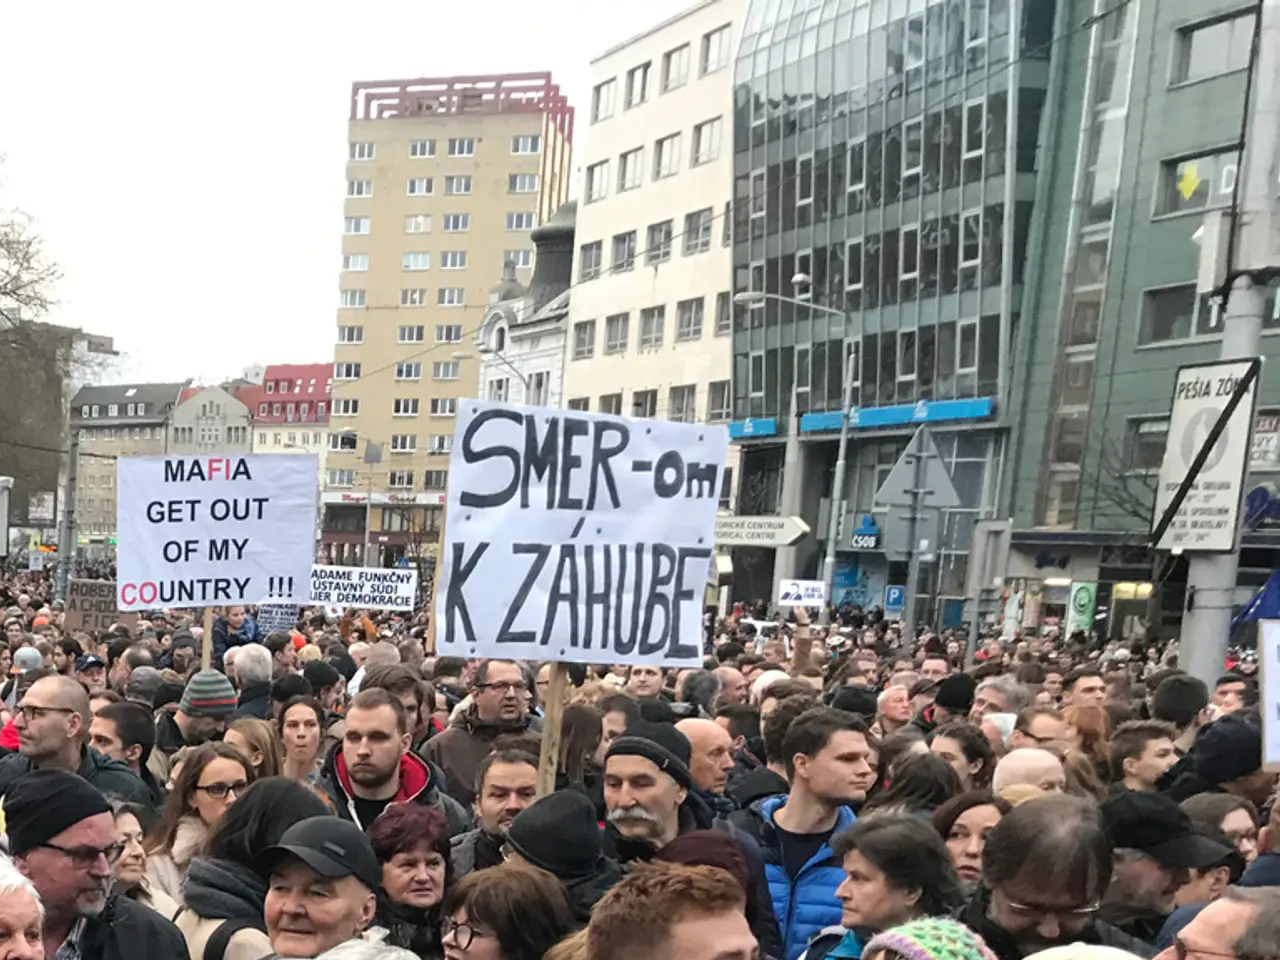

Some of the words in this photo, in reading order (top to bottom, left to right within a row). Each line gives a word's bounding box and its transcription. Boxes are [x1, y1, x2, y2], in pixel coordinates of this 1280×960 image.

[164, 458, 252, 482] MAFIA
[146, 500, 201, 523] GET
[210, 498, 269, 521] OUT
[163, 540, 199, 563] OF
[208, 538, 249, 561] MY
[121, 577, 251, 606] COUNTRY
[444, 542, 490, 642] K
[495, 516, 712, 658] ZÁHUBE
[889, 588, 900, 603] P
[337, 593, 412, 607] DEMOKRACIE
